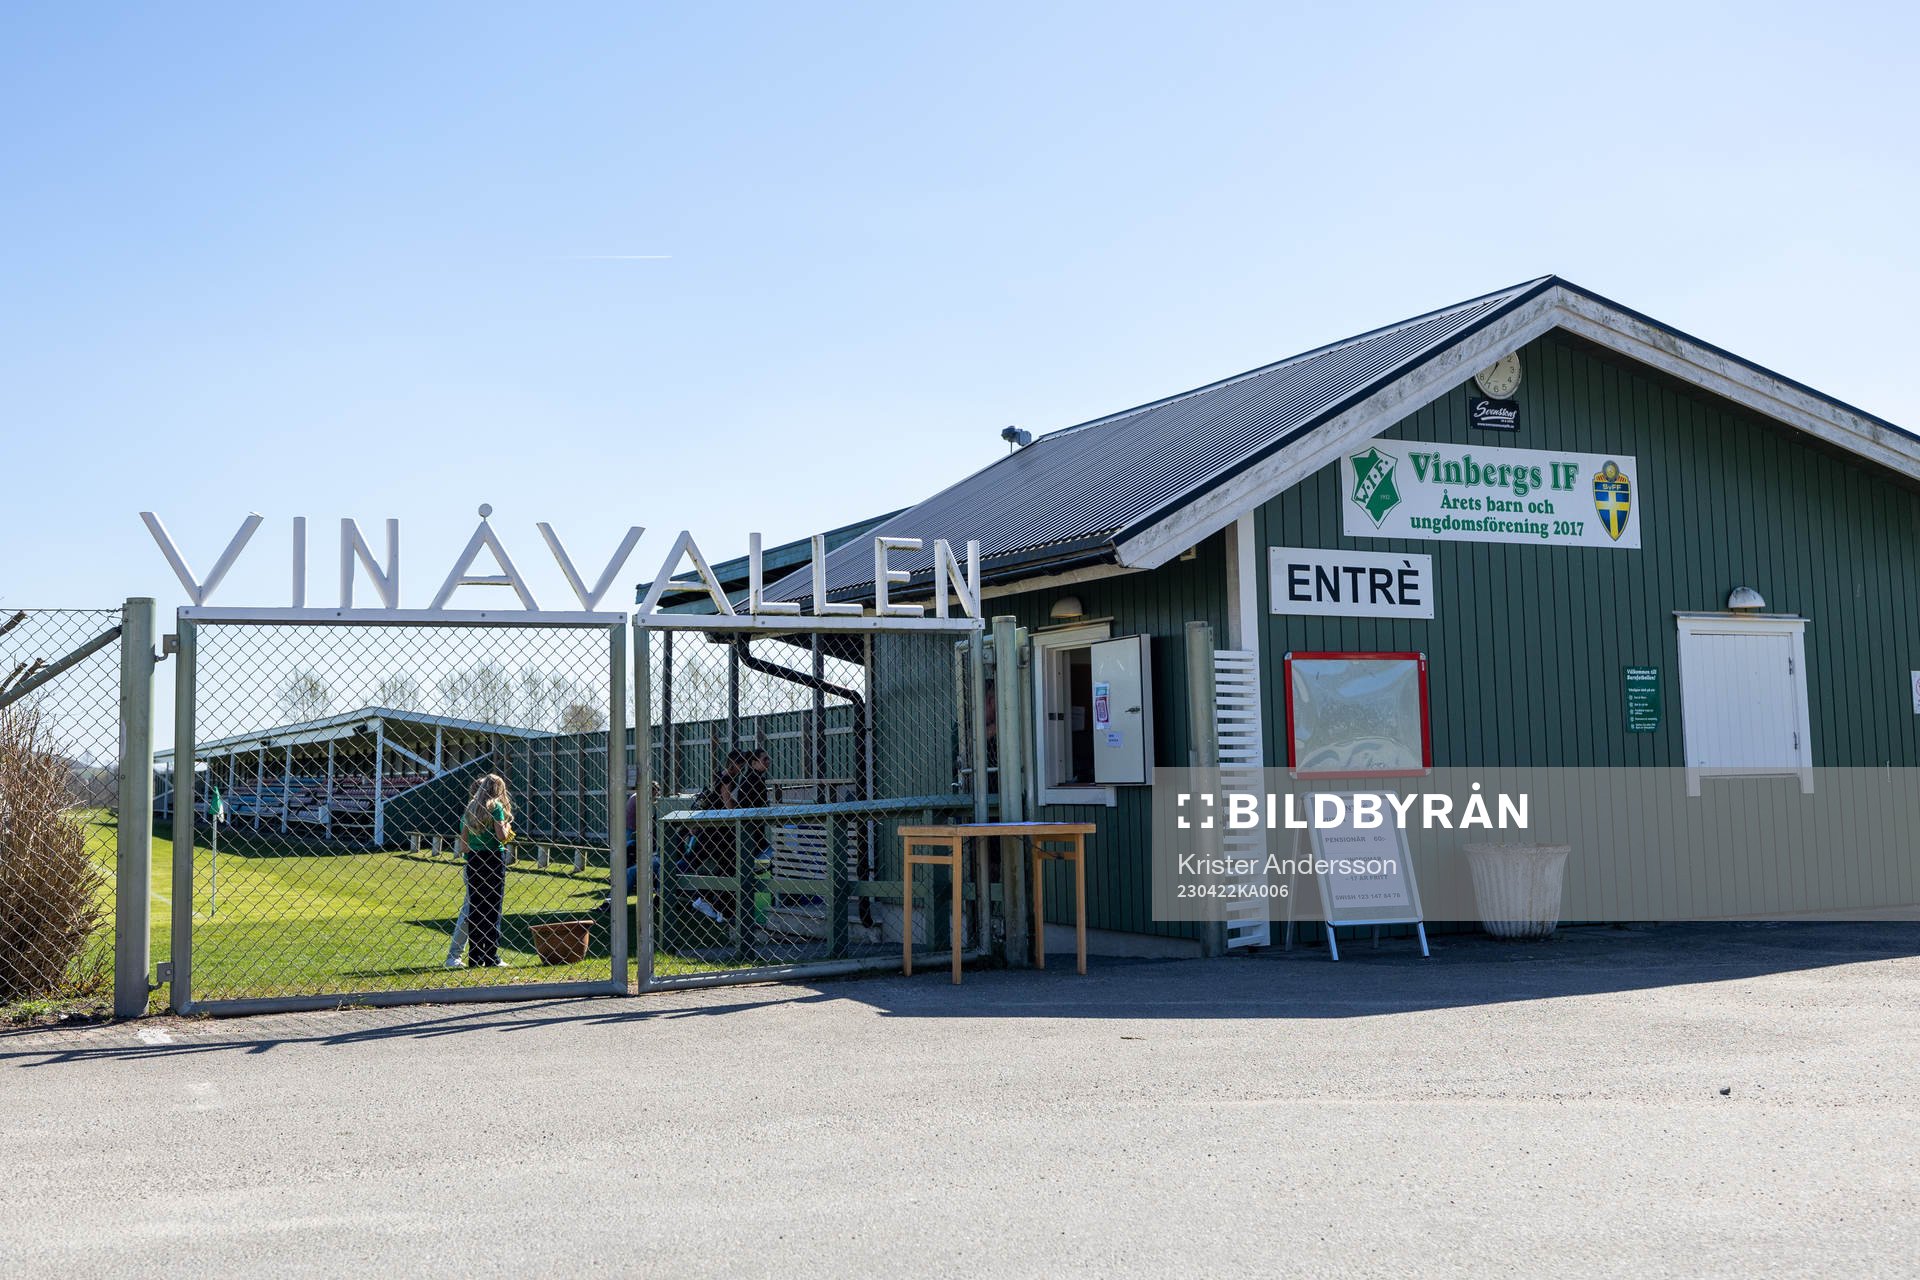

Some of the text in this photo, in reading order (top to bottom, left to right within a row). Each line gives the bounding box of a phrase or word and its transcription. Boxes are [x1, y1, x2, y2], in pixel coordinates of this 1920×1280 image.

[1408, 452, 1579, 497] Vinbergs IF
[1440, 489, 1555, 514] Årets barn och
[1410, 514, 1585, 539] ungdomsförening 2017
[1288, 560, 1421, 606] ENTRÈ
